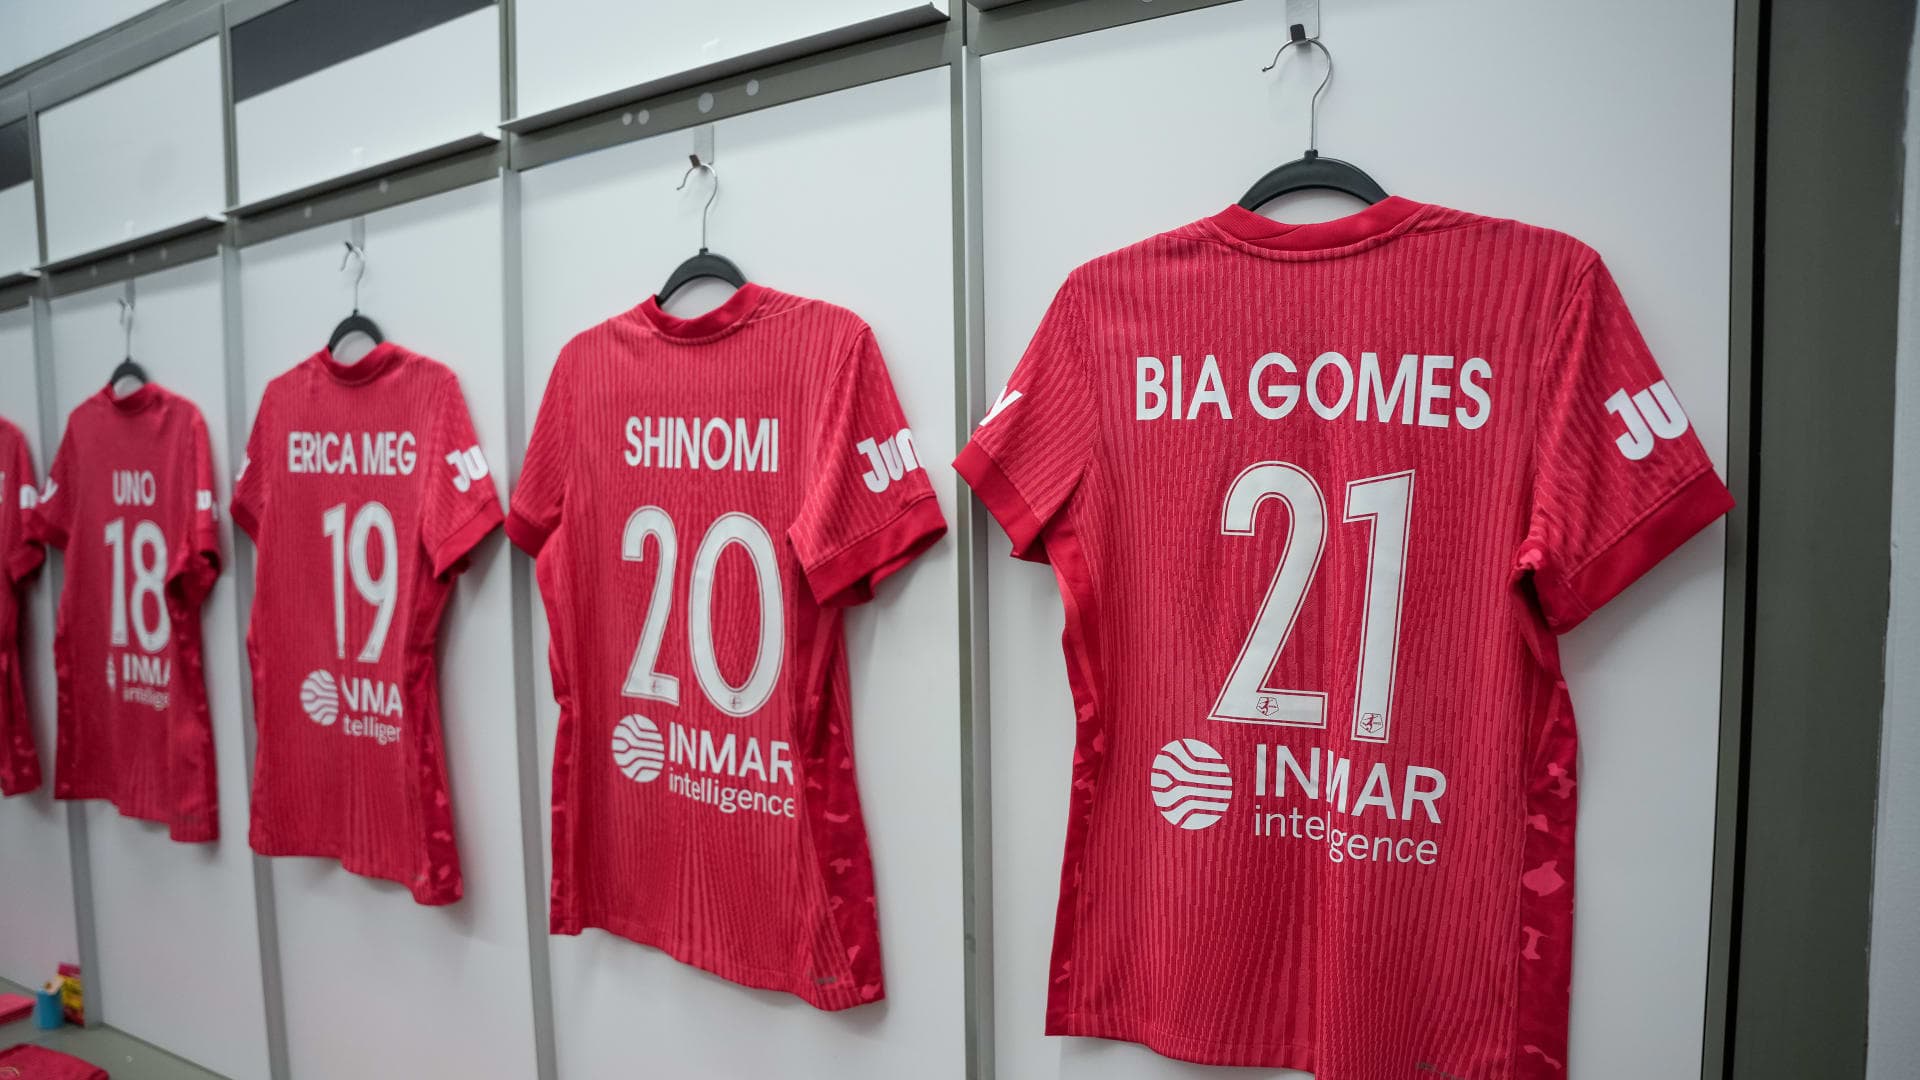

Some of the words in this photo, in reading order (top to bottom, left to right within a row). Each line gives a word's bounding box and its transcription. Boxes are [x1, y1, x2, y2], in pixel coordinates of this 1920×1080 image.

[1136, 355, 1232, 421] BIA
[1248, 351, 1493, 430] GOMES
[1603, 379, 1689, 461] Ju
[288, 431, 358, 475] ERICA
[362, 431, 417, 476] MEG
[624, 416, 779, 473] SHINOMI
[112, 470, 156, 506] UNO
[104, 518, 171, 653] 18
[323, 501, 398, 664] 19
[621, 505, 785, 718] 20
[1207, 461, 1416, 744] 21
[341, 674, 403, 718] NMA
[1255, 743, 1447, 824] INMAR
[1254, 804, 1439, 865] intelgence
